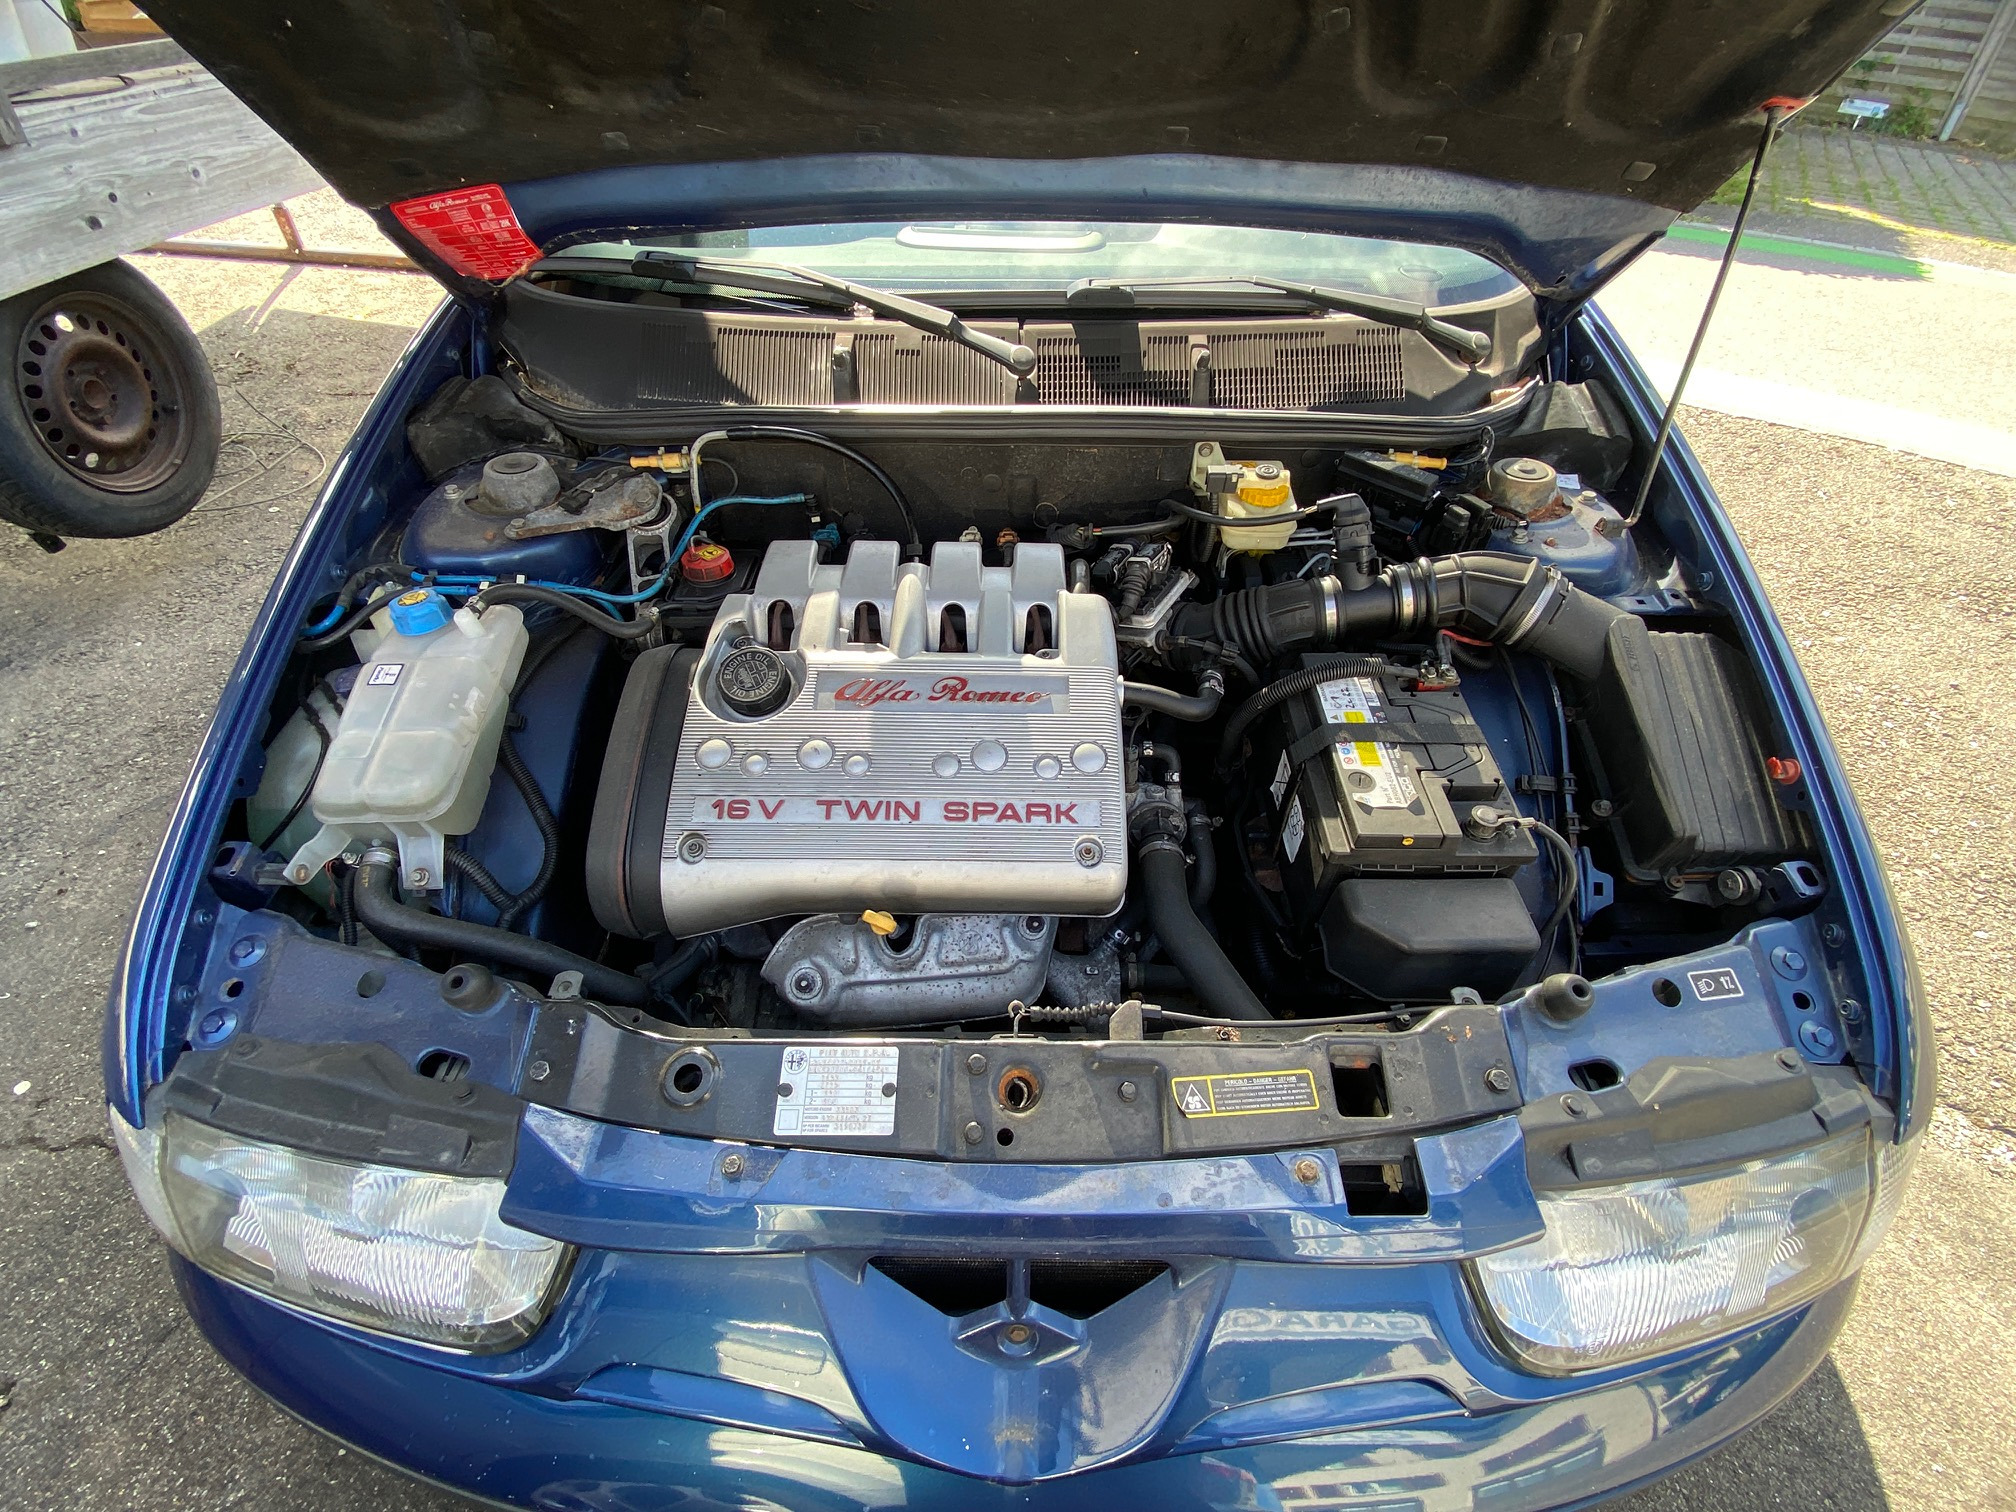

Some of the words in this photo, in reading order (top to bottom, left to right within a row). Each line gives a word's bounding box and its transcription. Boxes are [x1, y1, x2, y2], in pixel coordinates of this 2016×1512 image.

[724, 652, 752, 679] ENGINE
[755, 653, 770, 665] OIL
[730, 686, 746, 698] OIL
[750, 670, 777, 698] ENGINE
[834, 677, 920, 708] Alfa
[928, 676, 1051, 703] Romeo
[816, 800, 921, 822] TWIN
[943, 800, 1080, 824] SPARK
